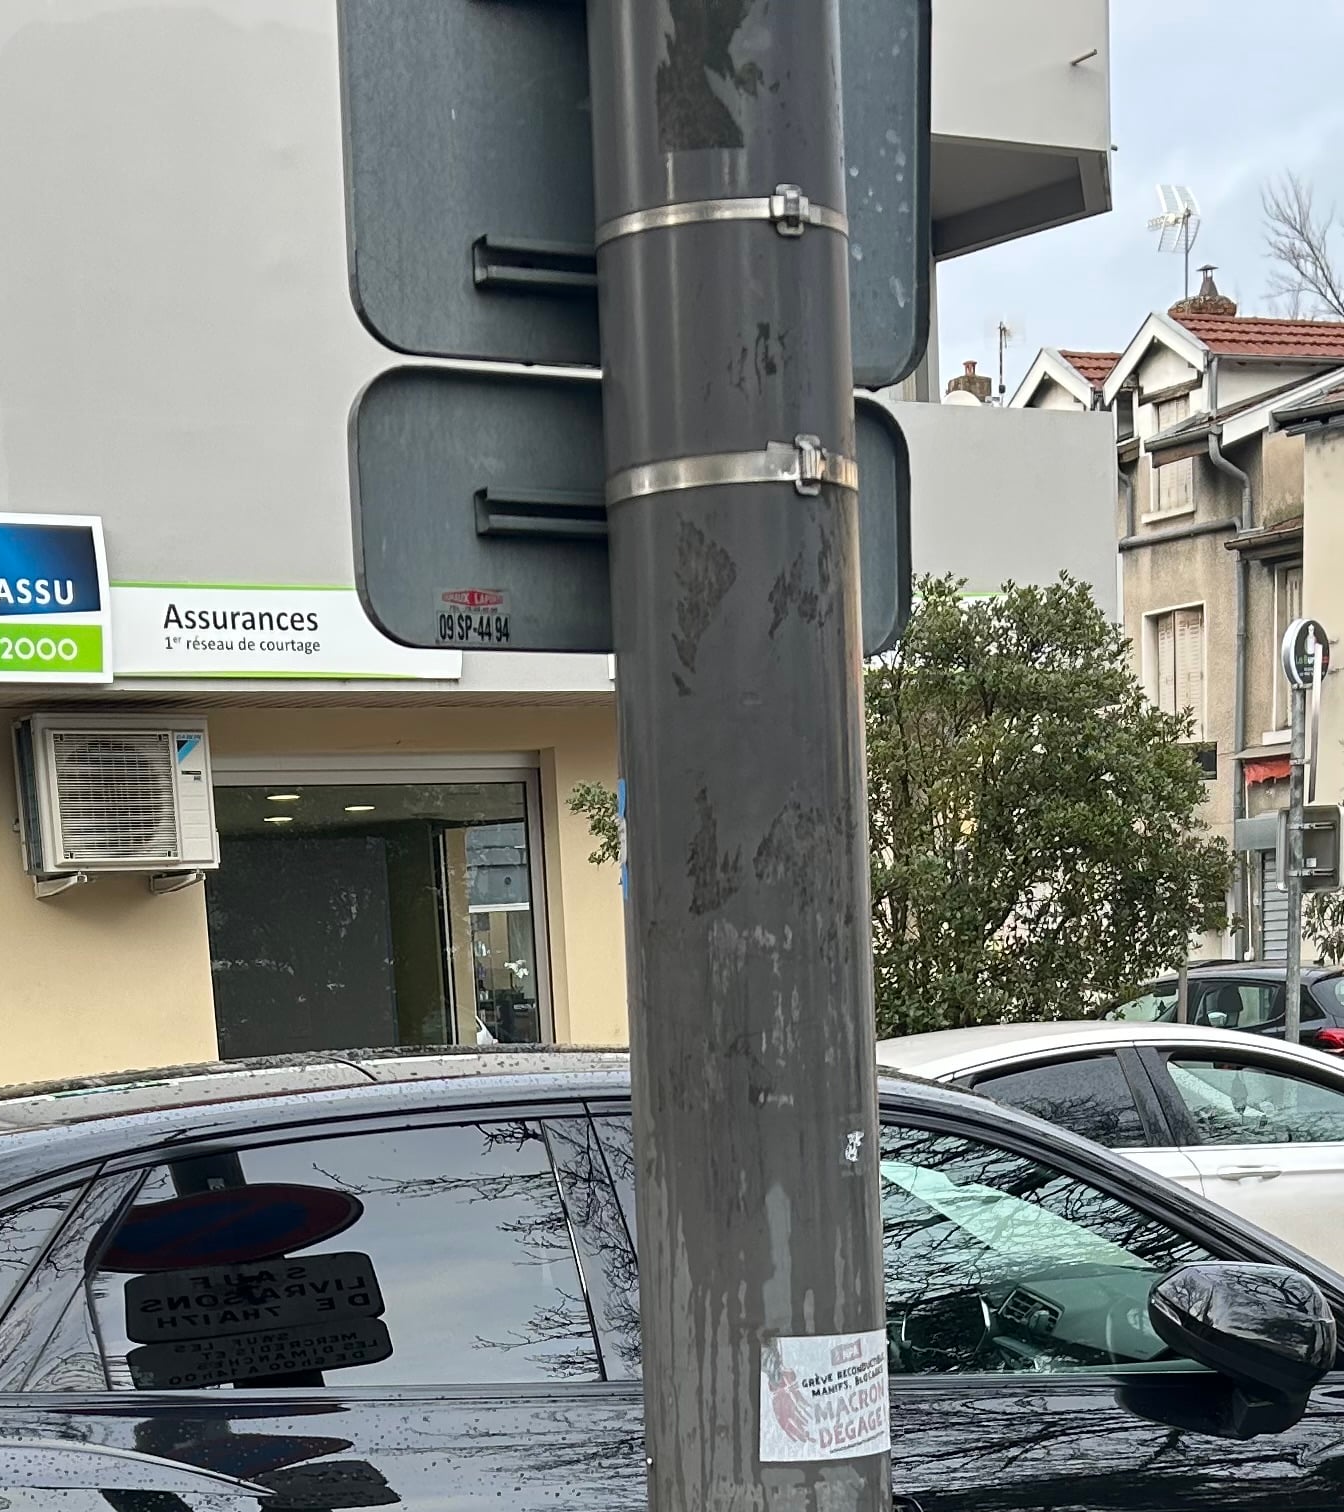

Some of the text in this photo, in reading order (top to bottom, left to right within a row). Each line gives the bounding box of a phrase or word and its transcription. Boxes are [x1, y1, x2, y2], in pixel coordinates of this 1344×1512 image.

[163, 603, 319, 631] Assurances
[439, 613, 454, 640] 09
[495, 615, 510, 642] 94
[186, 634, 234, 651] réseau
[238, 637, 256, 651] de
[259, 639, 321, 655] courtage
[814, 1377, 885, 1424] MACRON
